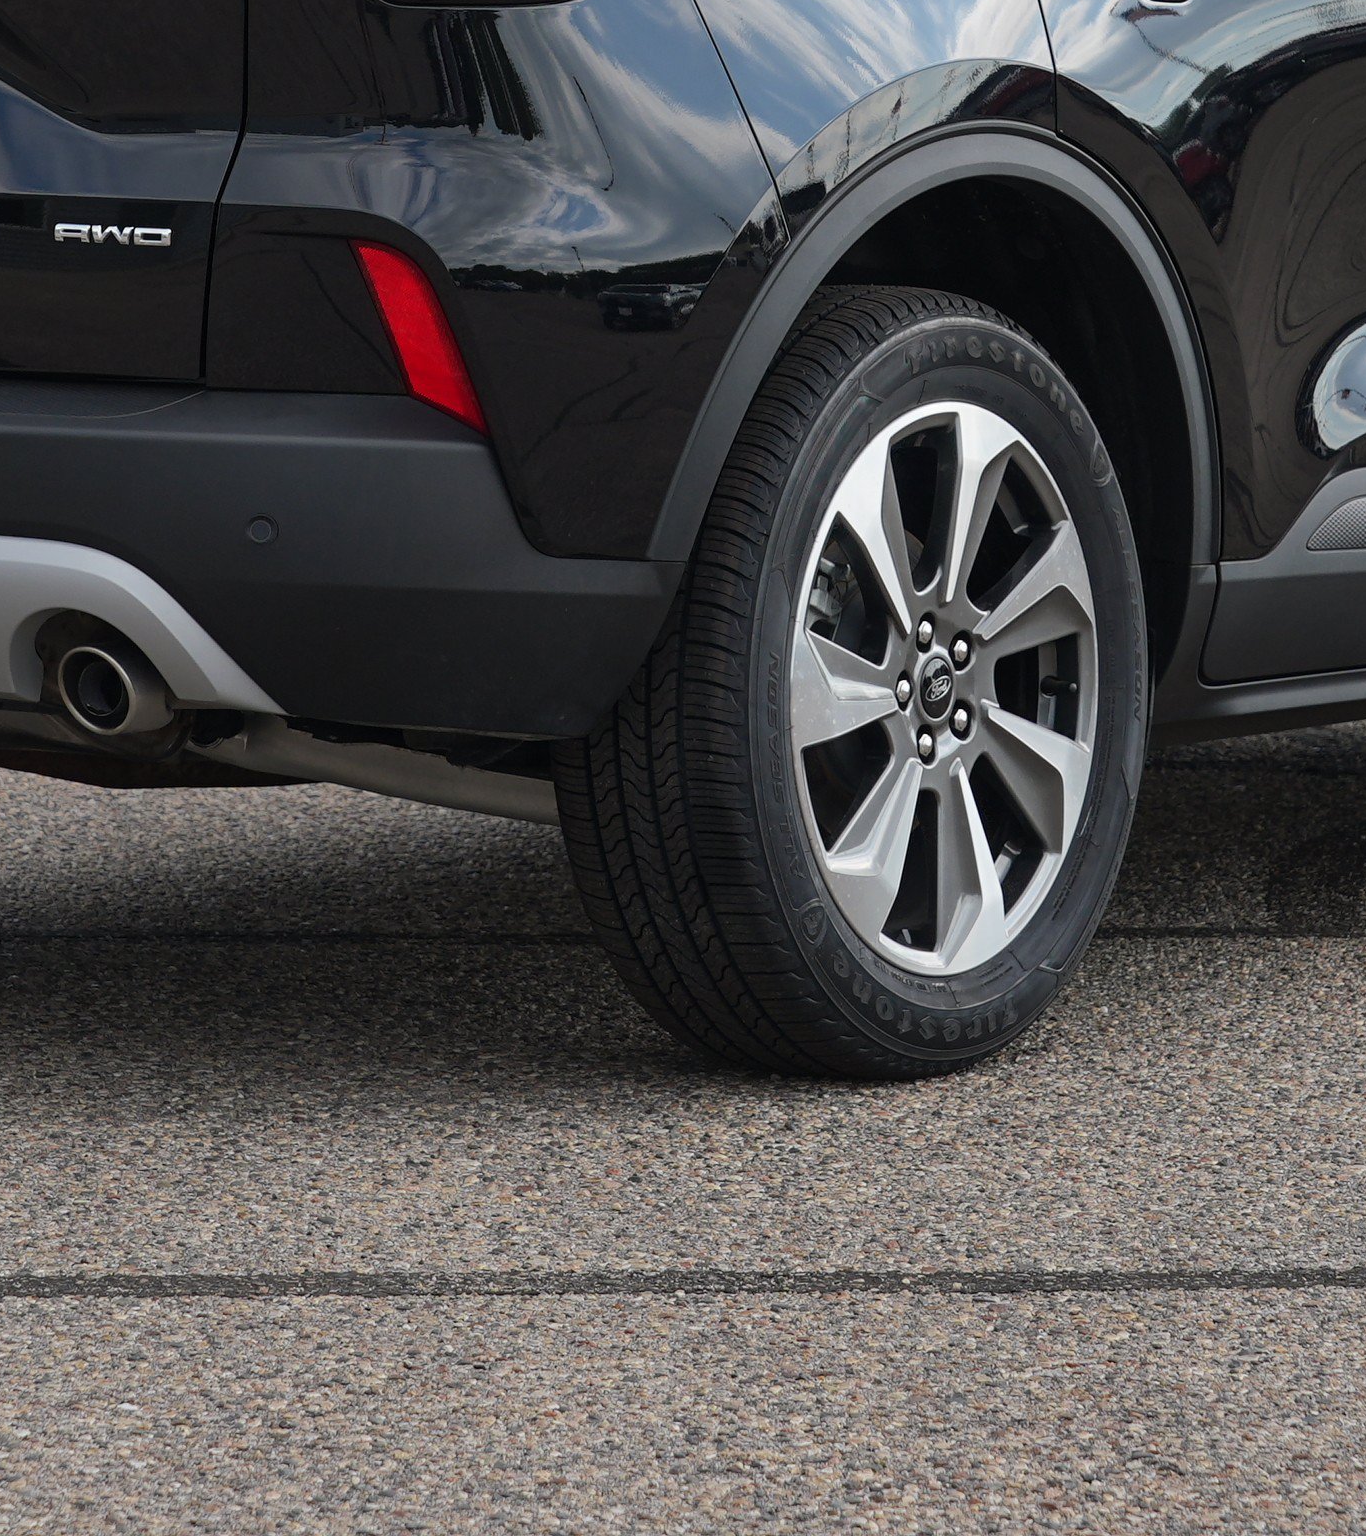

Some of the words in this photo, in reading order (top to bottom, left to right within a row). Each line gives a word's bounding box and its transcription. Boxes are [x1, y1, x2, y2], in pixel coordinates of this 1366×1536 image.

[54, 222, 173, 247] AWD
[904, 333, 1085, 437] Firestone
[766, 650, 786, 805] SEASON
[830, 948, 1019, 1043] Firestone
